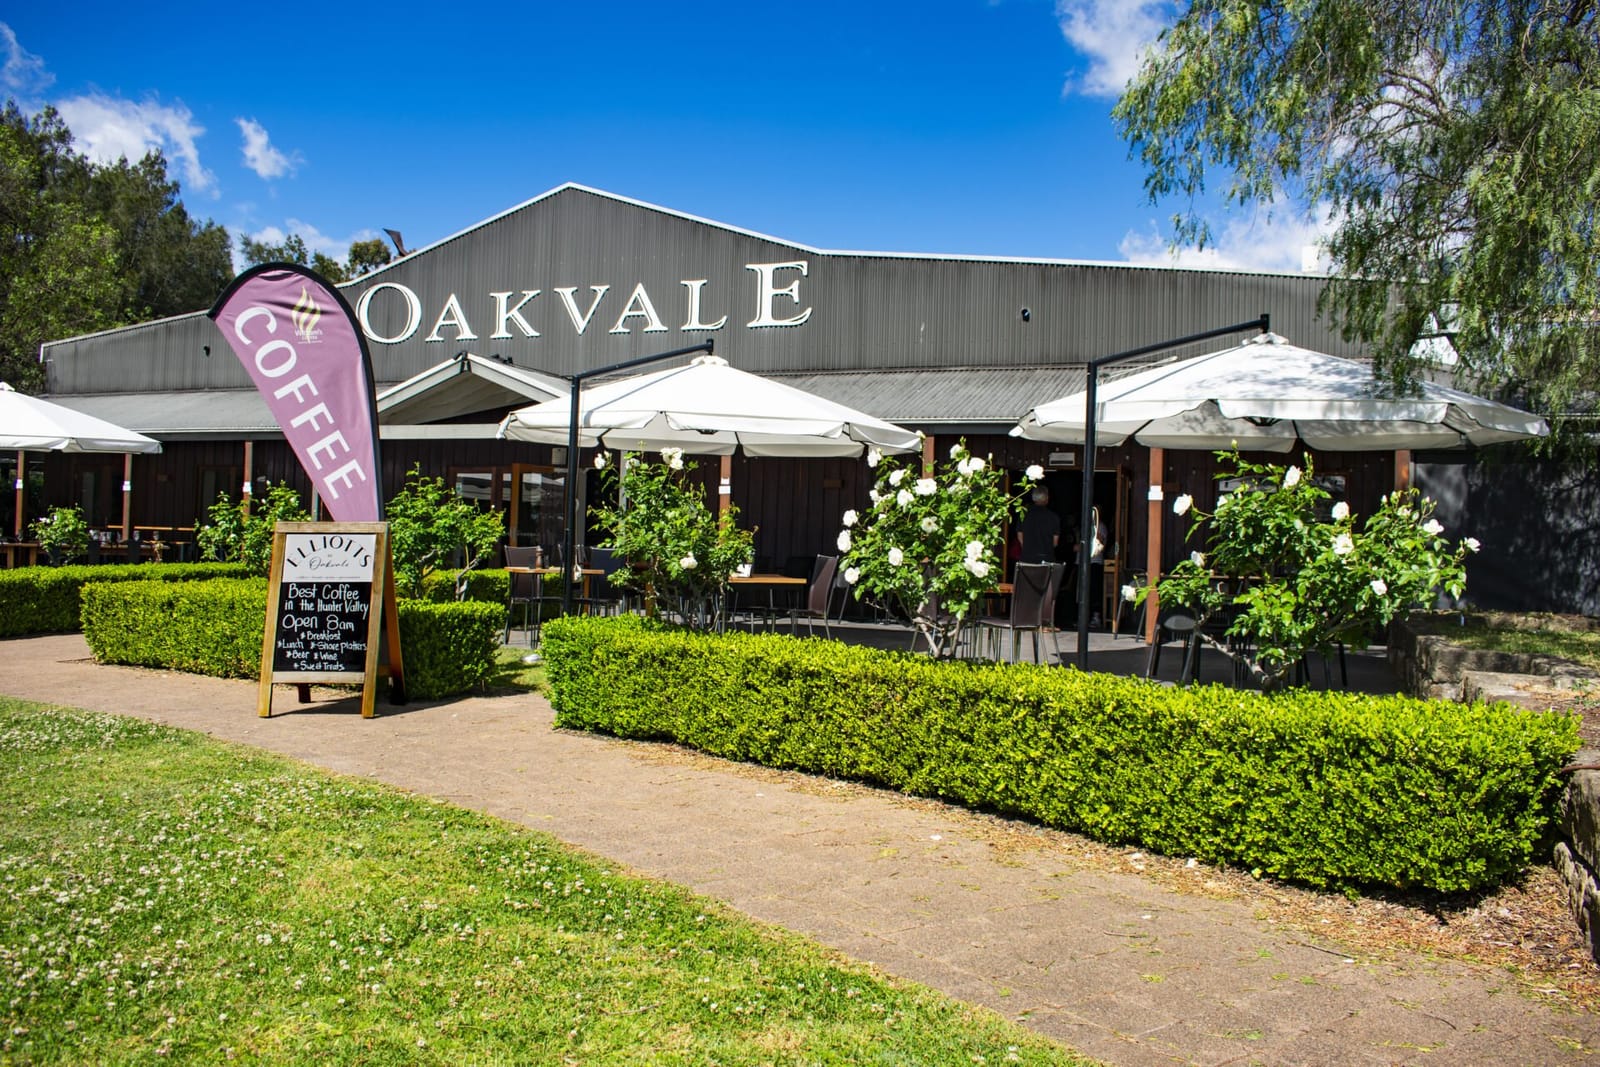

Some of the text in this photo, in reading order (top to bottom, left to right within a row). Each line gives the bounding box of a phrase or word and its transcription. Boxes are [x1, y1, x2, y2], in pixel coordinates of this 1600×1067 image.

[356, 260, 813, 344] OAKVALE
[234, 306, 367, 500] COFFEE
[288, 583, 360, 600] Best Coffee
[284, 598, 369, 620] in the Hunter Valley
[282, 614, 355, 632] Open 8am
[306, 630, 342, 641] Breakfast
[282, 639, 304, 650] Lunch
[317, 640, 340, 651] Share
[292, 650, 338, 660] Beer Wine
[300, 661, 322, 671] Sweet
